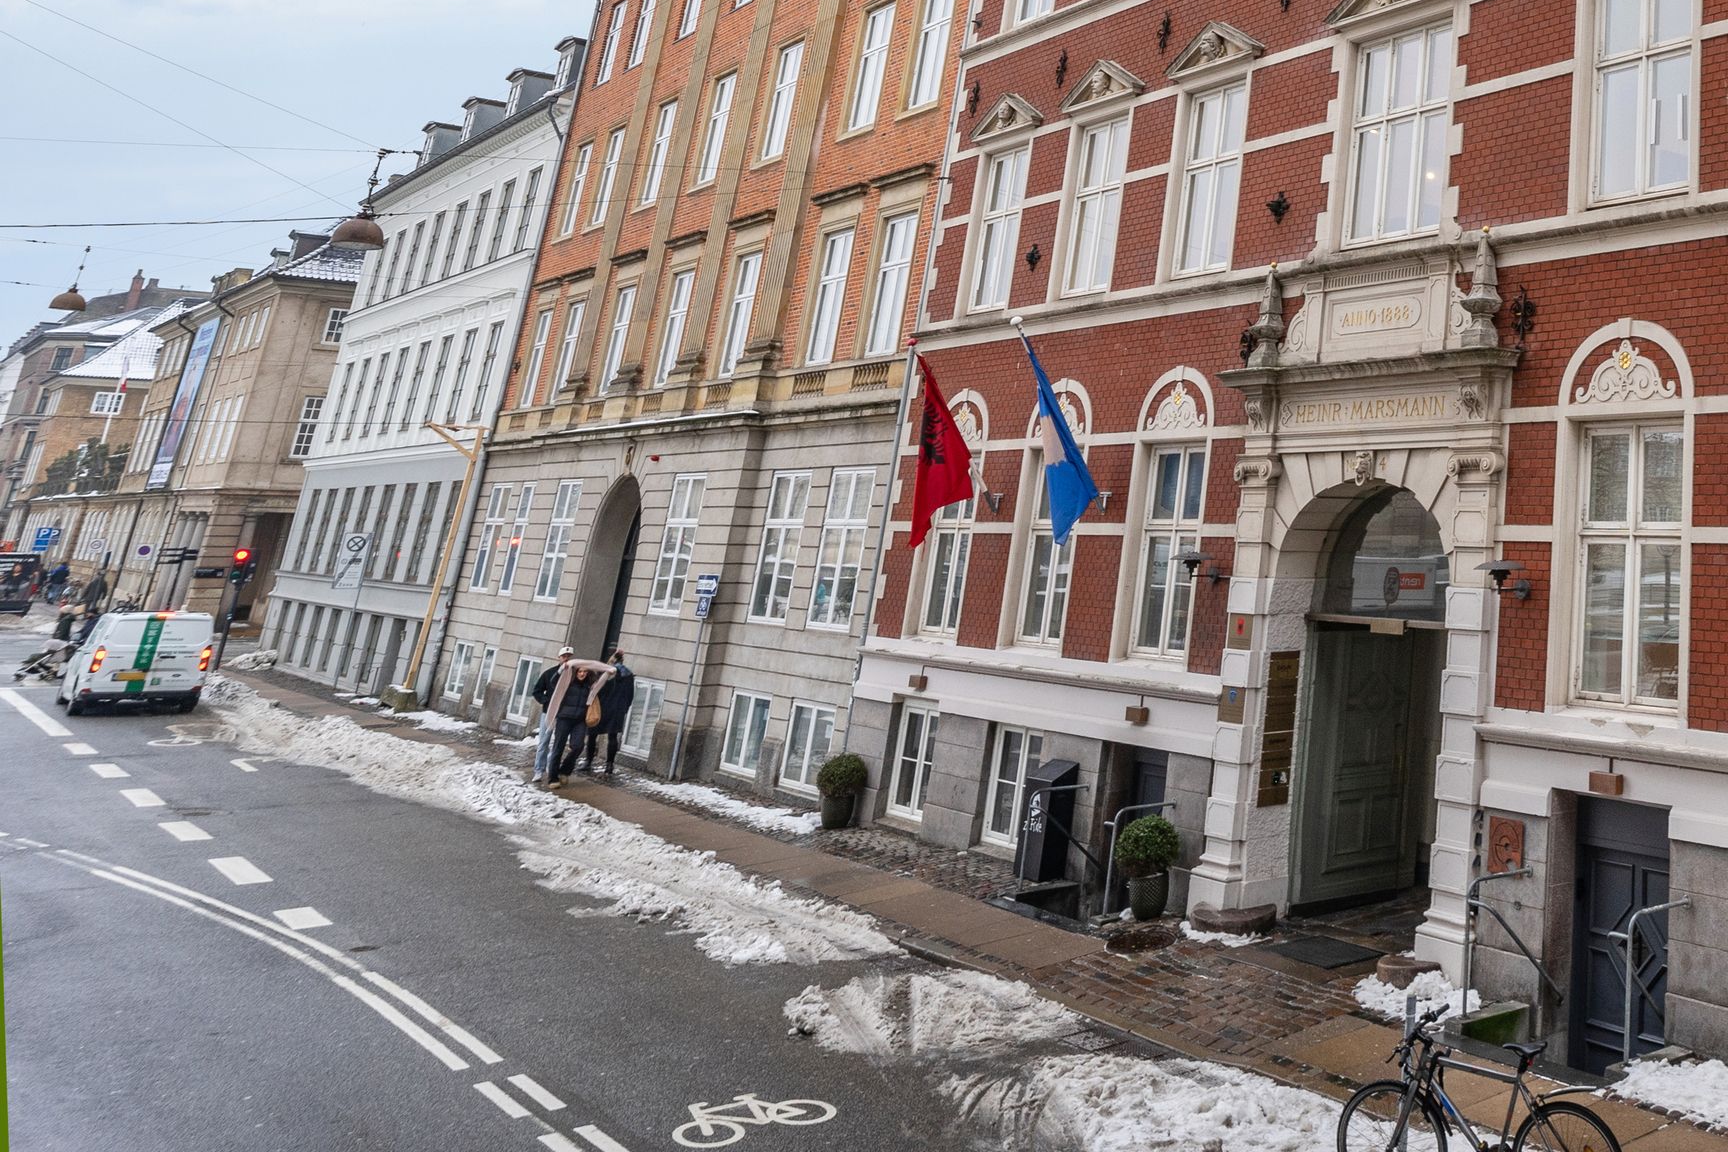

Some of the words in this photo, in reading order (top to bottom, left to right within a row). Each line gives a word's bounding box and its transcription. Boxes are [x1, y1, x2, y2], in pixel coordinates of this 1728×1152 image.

[1342, 309, 1376, 328] ANNO
[1381, 305, 1409, 323] 1888
[1351, 396, 1445, 420] MARSMANN
[38, 528, 51, 538] P
